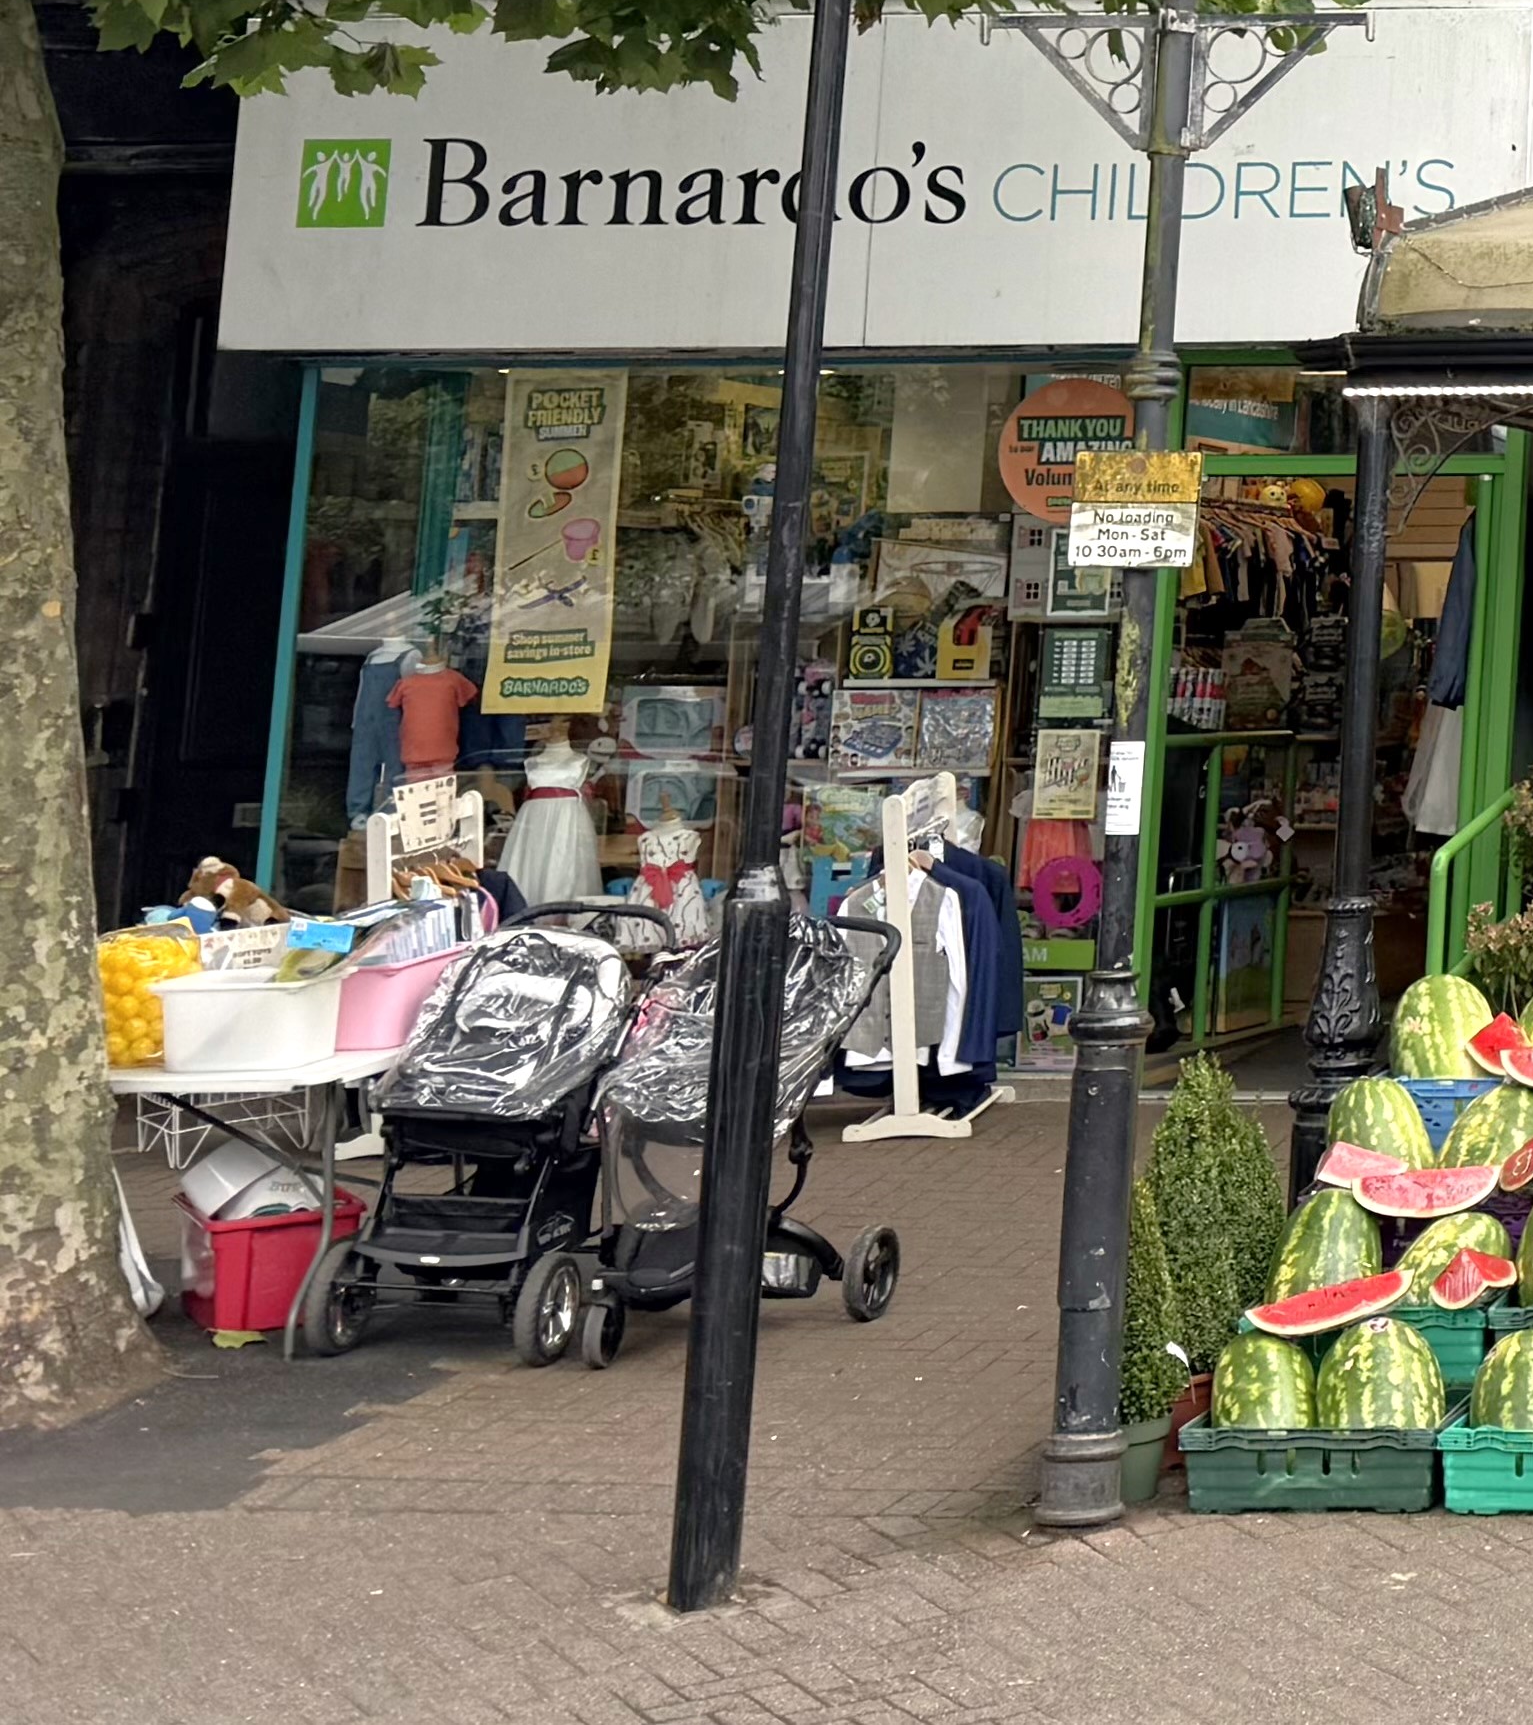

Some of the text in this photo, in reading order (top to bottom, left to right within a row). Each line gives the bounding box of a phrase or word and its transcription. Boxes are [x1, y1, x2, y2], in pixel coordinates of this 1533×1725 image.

[531, 390, 600, 409] POCKET
[527, 405, 602, 427] FRIENDLY
[1019, 417, 1121, 439] THANK YOU
[1115, 483, 1141, 495] any
[1094, 510, 1174, 525] No loading
[1097, 528, 1129, 541] Mon
[1140, 528, 1166, 541] Sat
[1153, 545, 1187, 559] 6pm
